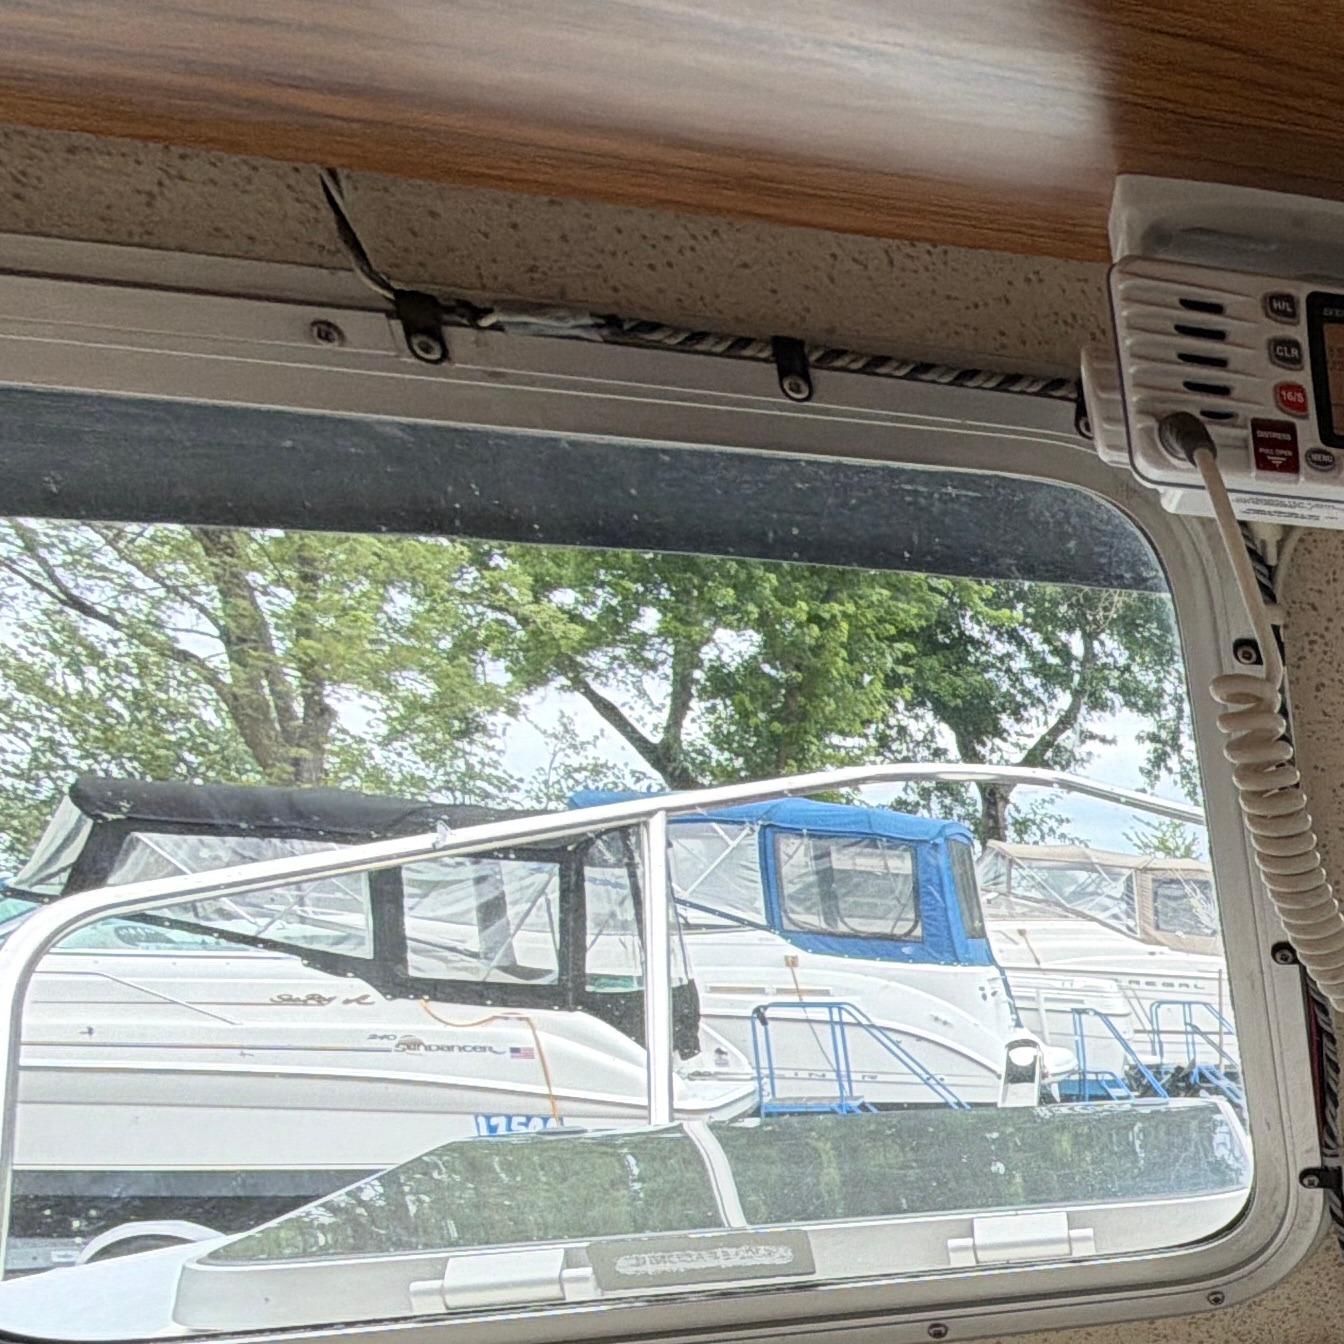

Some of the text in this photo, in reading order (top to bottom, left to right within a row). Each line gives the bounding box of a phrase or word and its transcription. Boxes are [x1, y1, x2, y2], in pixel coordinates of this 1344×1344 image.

[1273, 300, 1293, 312] H/L
[1276, 346, 1299, 358] CLR
[1281, 390, 1305, 403] 16/S
[1257, 430, 1292, 441] DISTRESS
[1310, 453, 1333, 463] MENU
